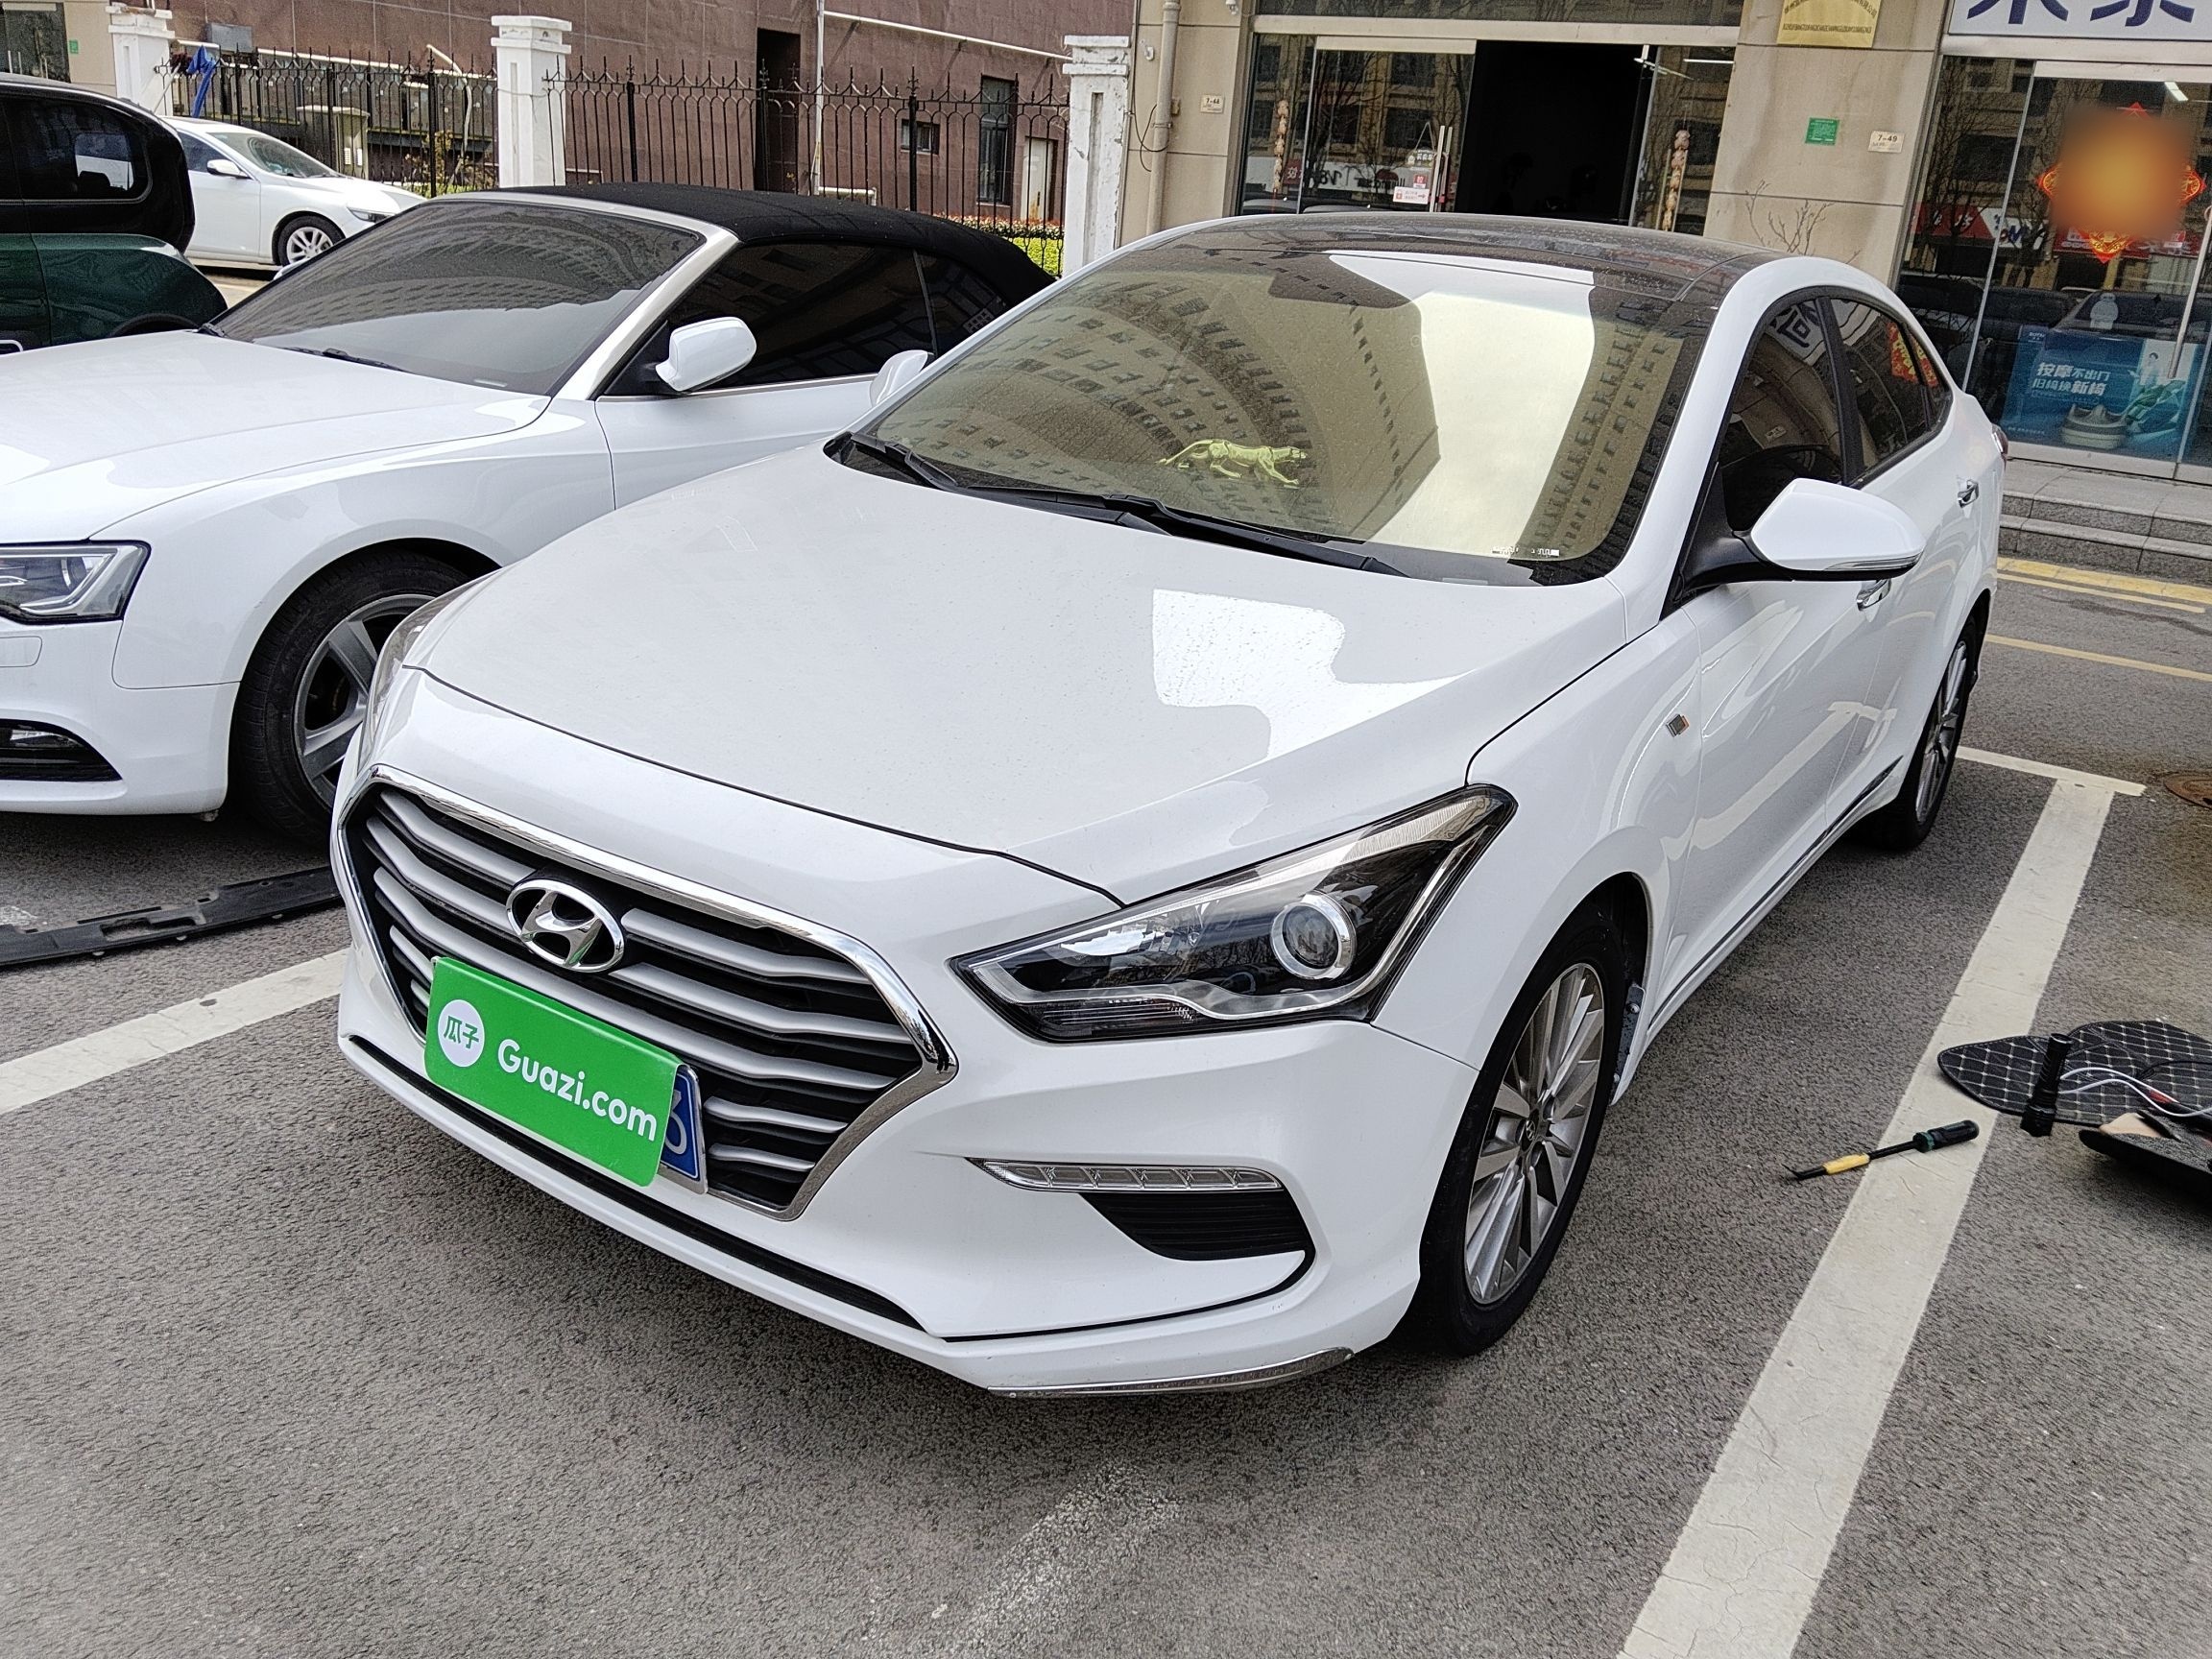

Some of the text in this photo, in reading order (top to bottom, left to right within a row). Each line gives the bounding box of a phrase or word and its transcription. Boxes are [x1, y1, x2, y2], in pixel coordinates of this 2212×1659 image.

[1878, 133, 1898, 142] 7-49
[443, 1015, 480, 1049] 瓜子
[497, 1038, 658, 1142] Guazi.com
